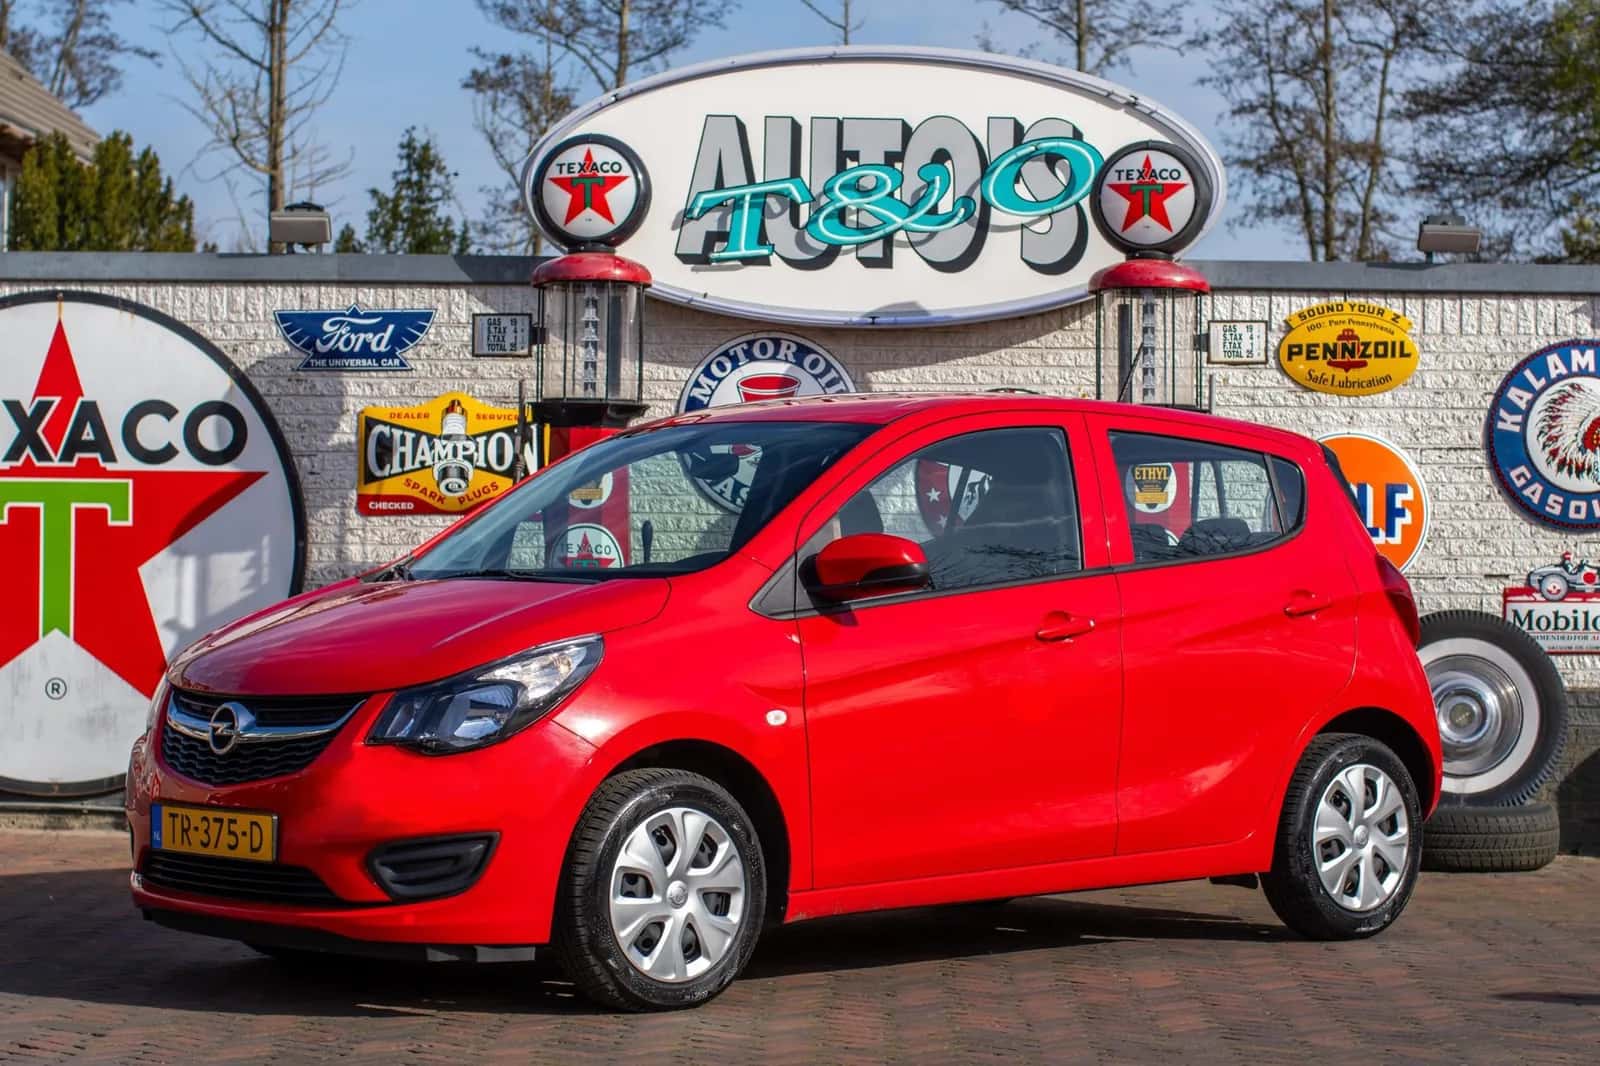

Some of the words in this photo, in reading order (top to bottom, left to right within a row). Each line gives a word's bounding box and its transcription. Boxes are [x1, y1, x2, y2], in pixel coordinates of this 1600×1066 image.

[556, 161, 622, 174] TEXACO
[1115, 168, 1181, 181] TEXACO
[487, 318, 501, 326] GAS
[1298, 303, 1344, 321] SOUND
[1349, 304, 1385, 317] YOUR
[1391, 313, 1400, 324] Z
[315, 316, 395, 352] Ford
[487, 344, 507, 352] TOTAL
[1223, 350, 1243, 358] TOTAL
[1287, 341, 1412, 361] PENNZOIL
[691, 339, 798, 405] MOTOR
[1305, 369, 1329, 385] Safe
[1330, 374, 1392, 389] Lubrication
[1497, 350, 1595, 432] KALAM
[2, 399, 248, 466] XACO
[367, 423, 539, 477] CHAMPION
[1135, 467, 1168, 480] ETHYL
[404, 478, 446, 504] SPARK
[458, 481, 499, 504] PLUGS
[369, 502, 414, 510] CHECKED
[1350, 483, 1414, 544] LF
[168, 813, 264, 853] TR-375-D
